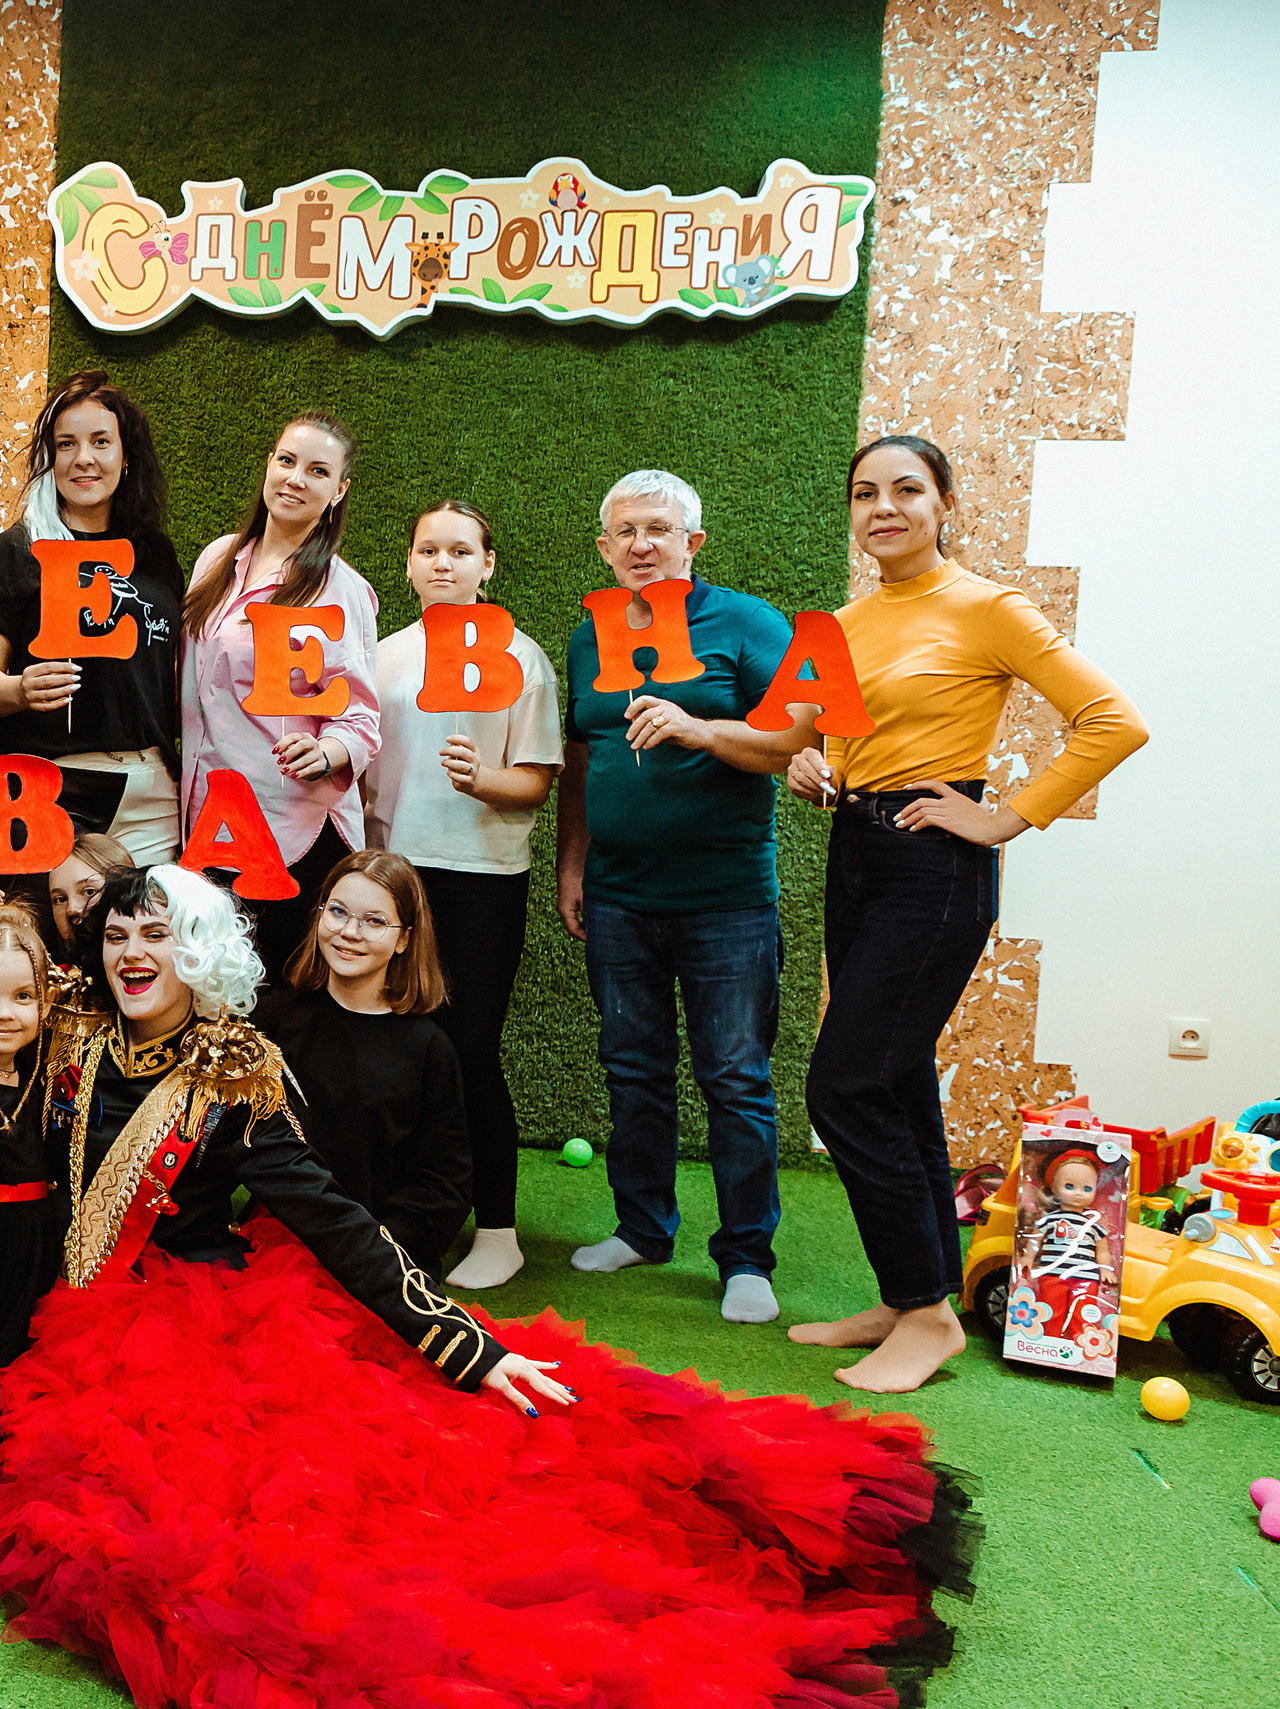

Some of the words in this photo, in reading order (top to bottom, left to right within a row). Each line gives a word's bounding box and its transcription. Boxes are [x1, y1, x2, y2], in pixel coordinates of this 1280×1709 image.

[81, 201, 169, 317] С
[189, 189, 416, 300] ДНЁМ
[1017, 1340, 1058, 1357] Весна
